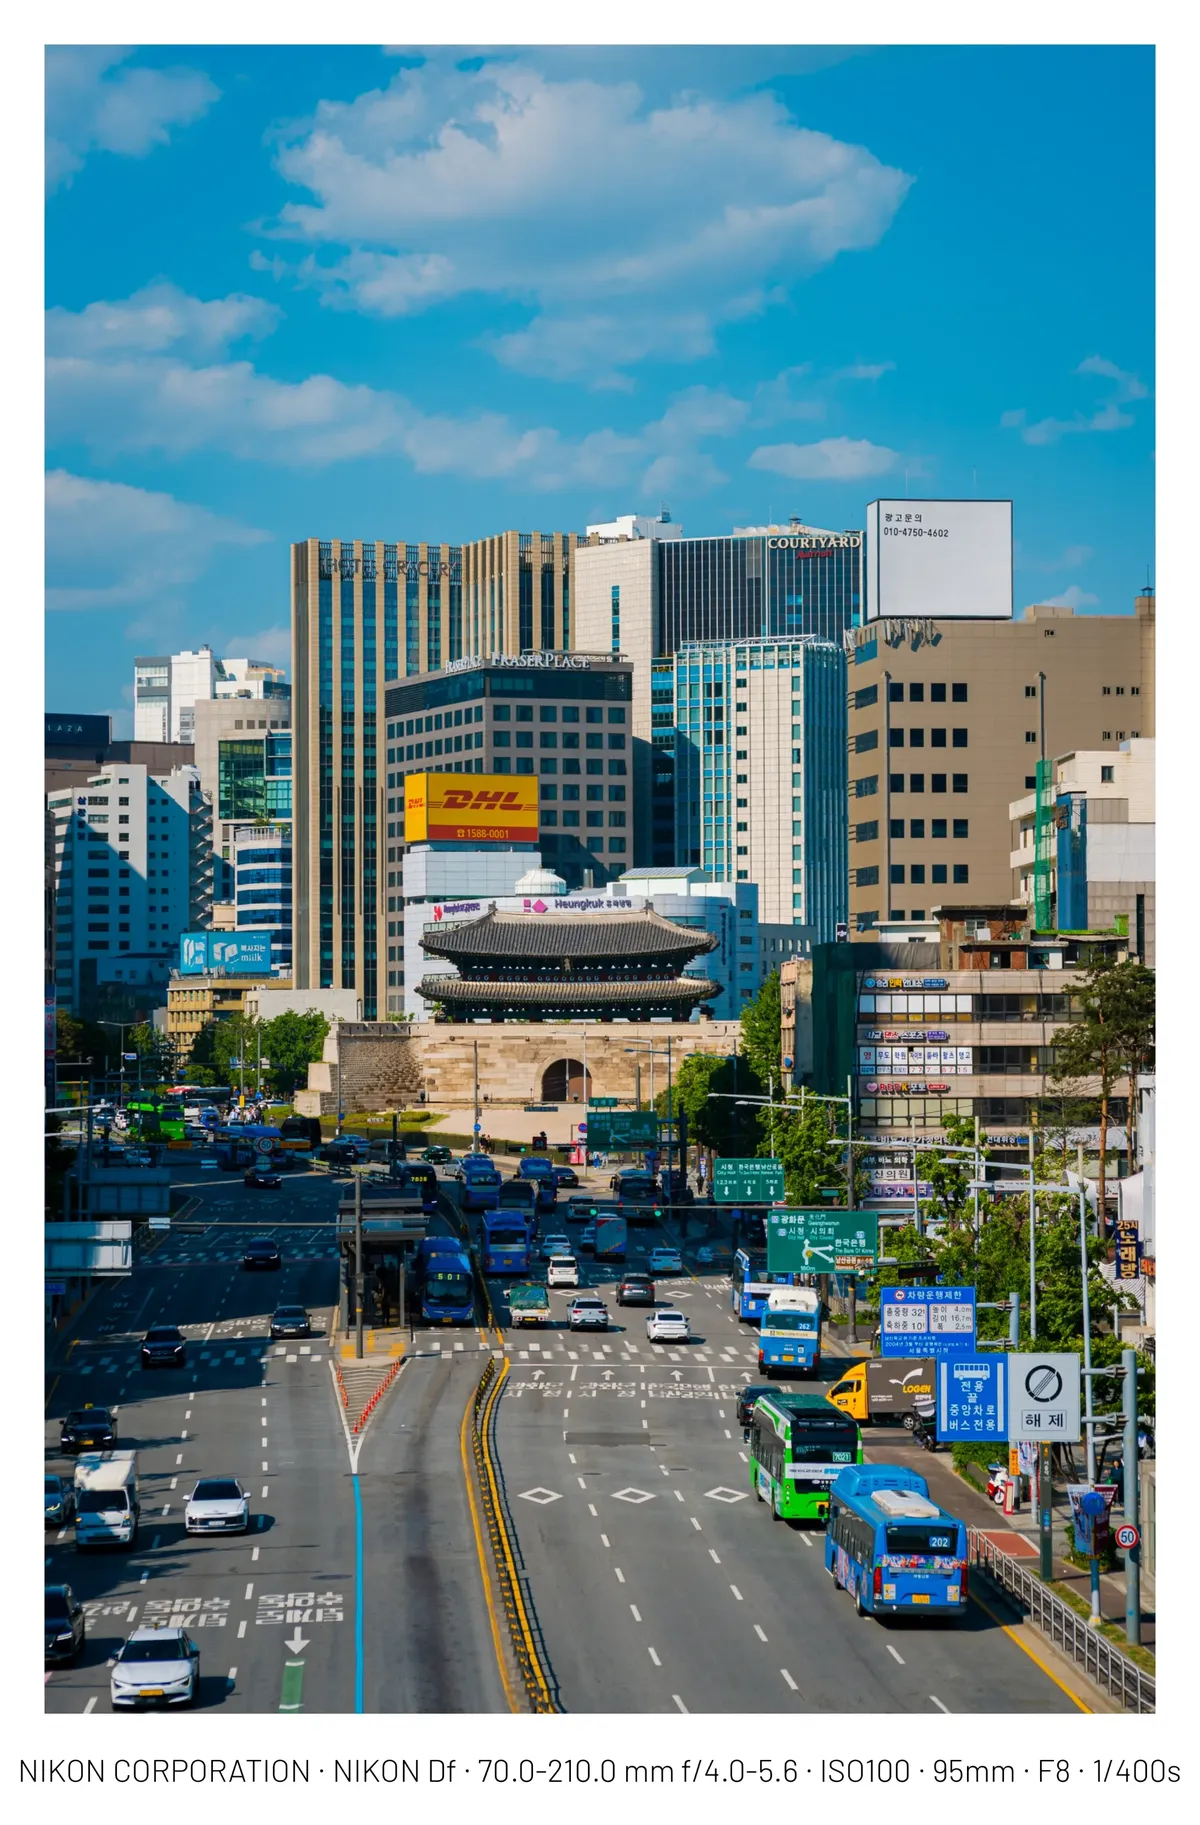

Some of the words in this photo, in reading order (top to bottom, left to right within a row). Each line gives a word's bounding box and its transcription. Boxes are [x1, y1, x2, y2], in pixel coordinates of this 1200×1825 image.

[885, 513, 922, 522] 광고문의
[884, 527, 949, 537] 010-4750-4602
[768, 537, 861, 549] COURTYARD
[442, 789, 524, 811] DHL
[467, 828, 509, 839] 1588-0001
[554, 898, 604, 911] Heungkuk
[781, 1215, 805, 1224] 광화문
[1117, 1220, 1138, 1230] 25시
[789, 1227, 804, 1235] 시청
[810, 1227, 834, 1235] 시의회
[835, 1239, 866, 1247] 한국은행
[1120, 1230, 1137, 1278] 노래방
[907, 1291, 962, 1300] 차량운행제한
[887, 1307, 908, 1317] 총중량
[932, 1306, 947, 1314] 높이
[887, 1321, 908, 1330] 축하중
[903, 1385, 931, 1393] LOGEN
[961, 1381, 984, 1392] 전용
[949, 1404, 995, 1416] 중앙차로
[949, 1419, 995, 1431] 버스전용
[1025, 1413, 1063, 1427] 해제
[834, 1453, 849, 1461] 7021
[931, 1537, 948, 1547] 202
[1120, 1531, 1135, 1543] 50
[258, 1592, 343, 1609] 후암동
[255, 1608, 344, 1625] 퇴계로
